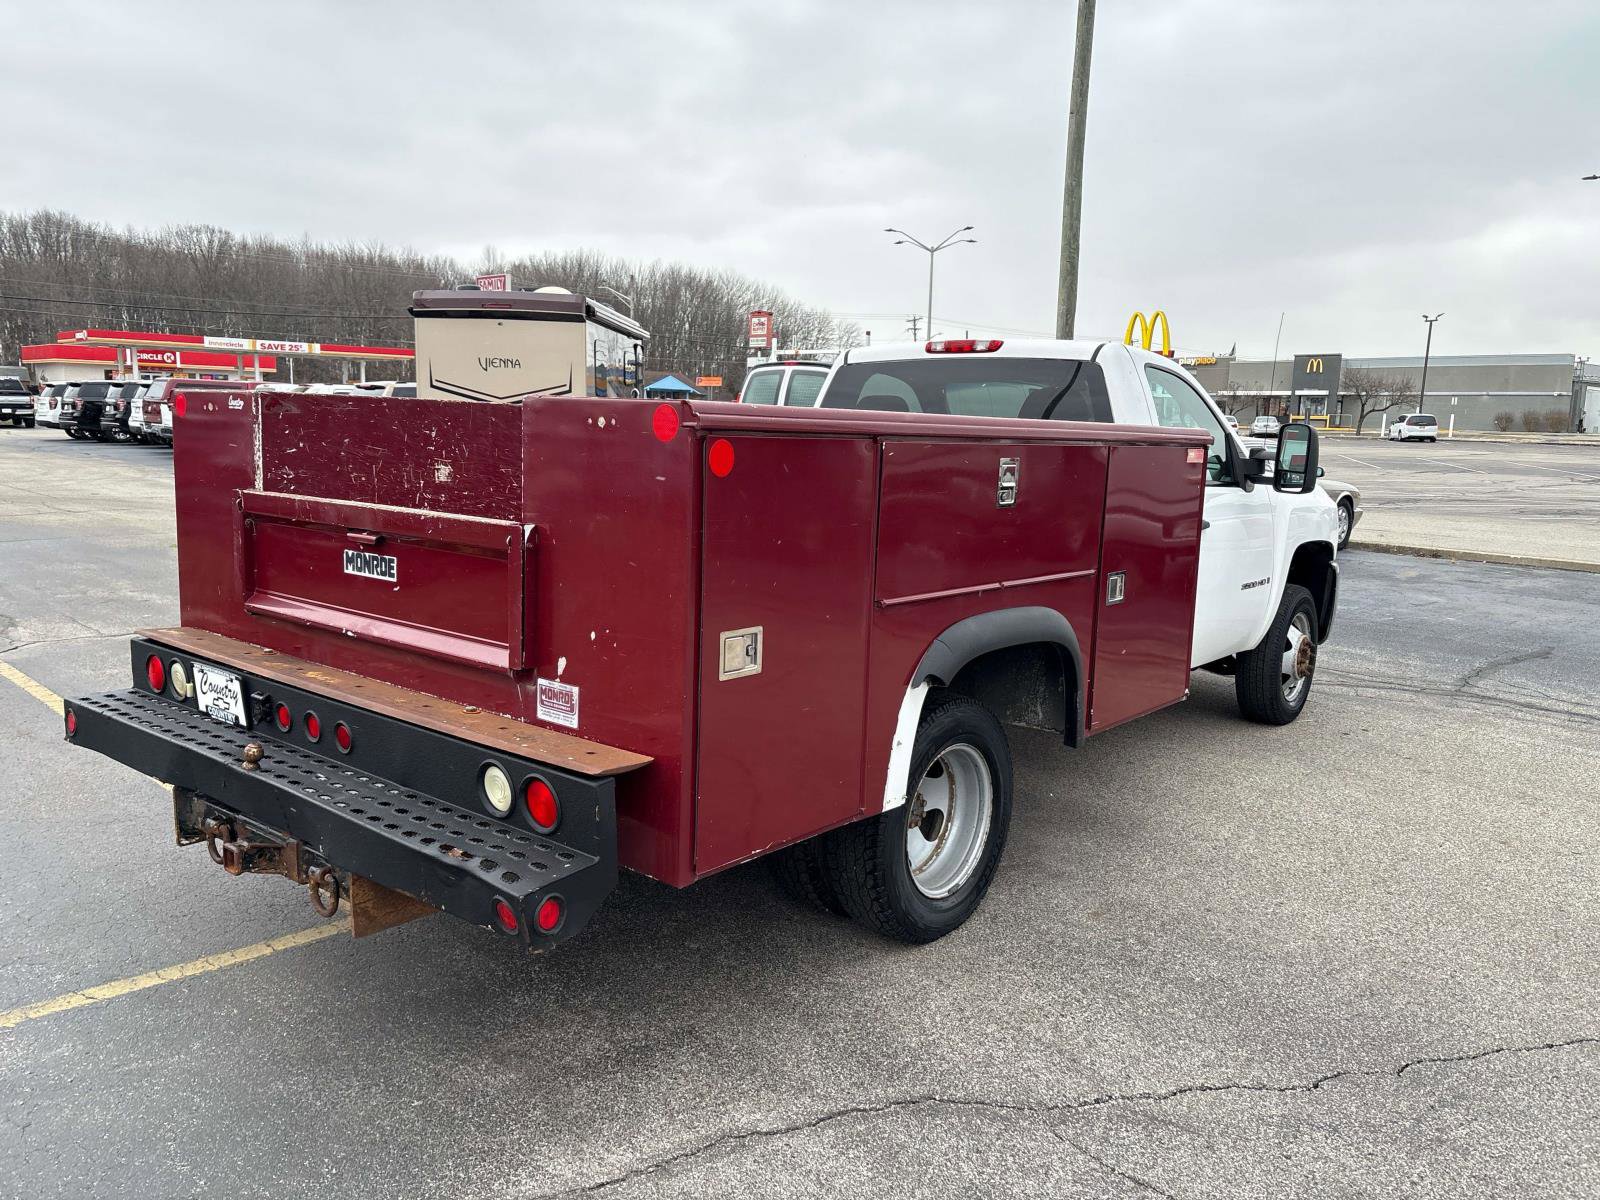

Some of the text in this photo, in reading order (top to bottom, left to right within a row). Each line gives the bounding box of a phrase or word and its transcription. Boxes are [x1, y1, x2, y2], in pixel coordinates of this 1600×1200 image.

[479, 278, 504, 291] FAMILY
[260, 342, 286, 351] SAVE
[164, 353, 175, 362] K
[478, 357, 521, 372] VIENNA
[1178, 357, 1217, 366] playplace
[345, 550, 396, 578] MONROE
[200, 672, 239, 707] Country
[541, 685, 574, 704] MONROE
[208, 706, 236, 722] COUNTRY
